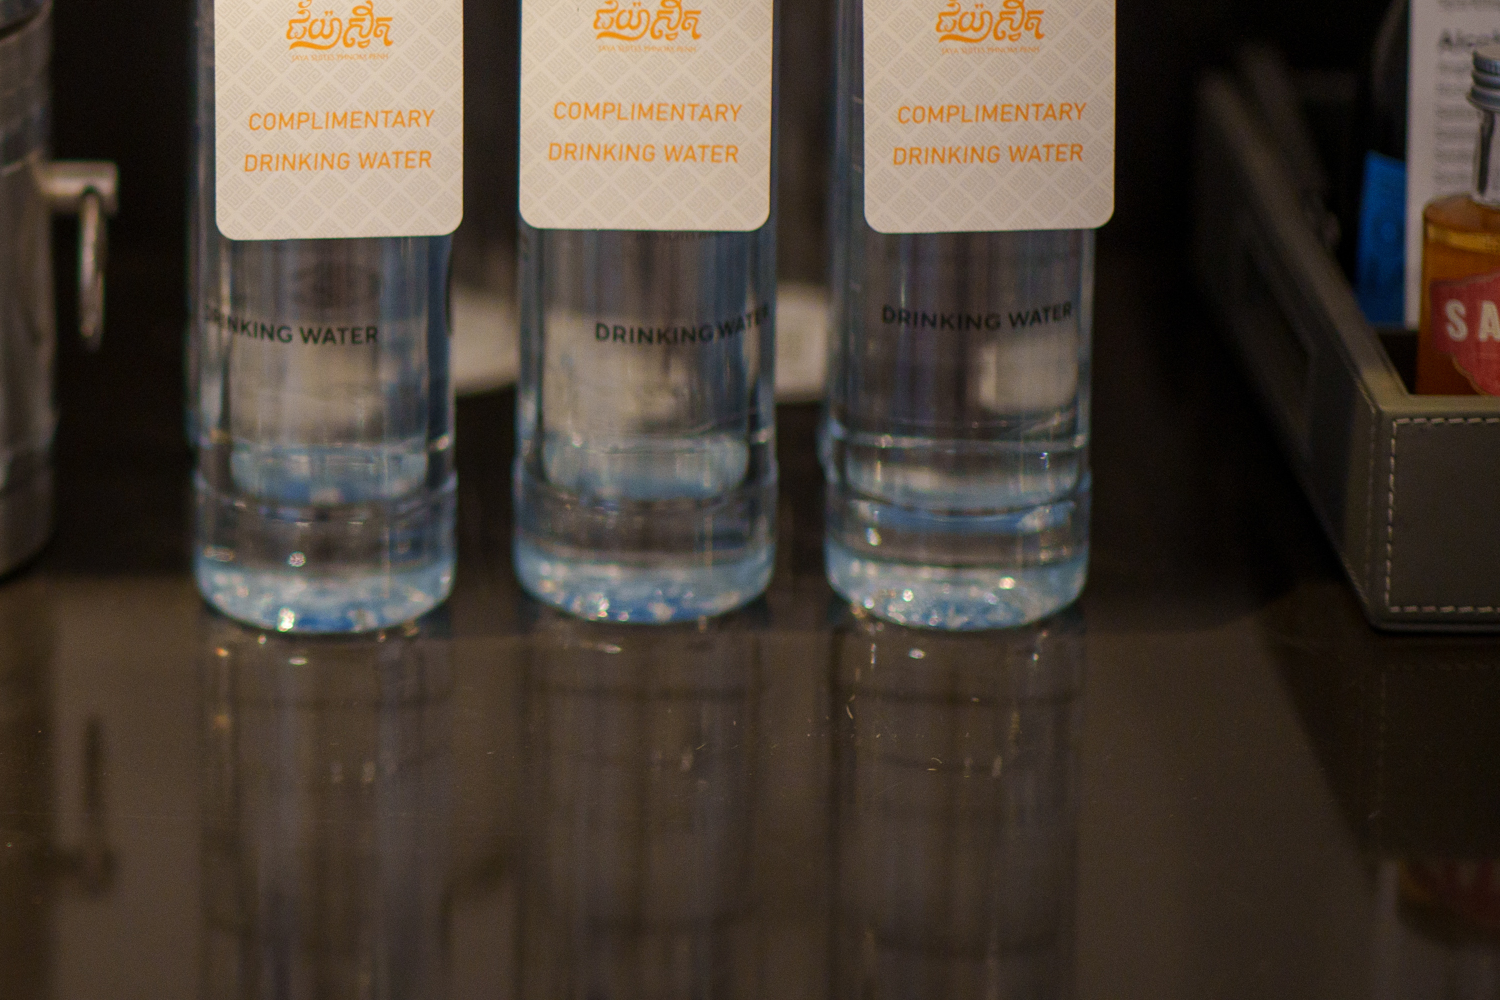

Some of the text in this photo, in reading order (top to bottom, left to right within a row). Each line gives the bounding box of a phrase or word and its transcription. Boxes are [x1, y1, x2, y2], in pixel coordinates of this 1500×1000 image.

[248, 109, 435, 132] COMPLIMENTARY
[553, 102, 743, 122] COMPLIMENTARY
[896, 103, 1087, 124] COMPLIMENTARY
[244, 149, 432, 173] DRINKING WATER
[547, 143, 739, 164] DRINKING WATER
[892, 144, 1084, 165] DRINKING WATER
[882, 301, 1072, 331] DRINKING WATER
[300, 326, 378, 345] WATER
[595, 322, 714, 344] DRINKING
